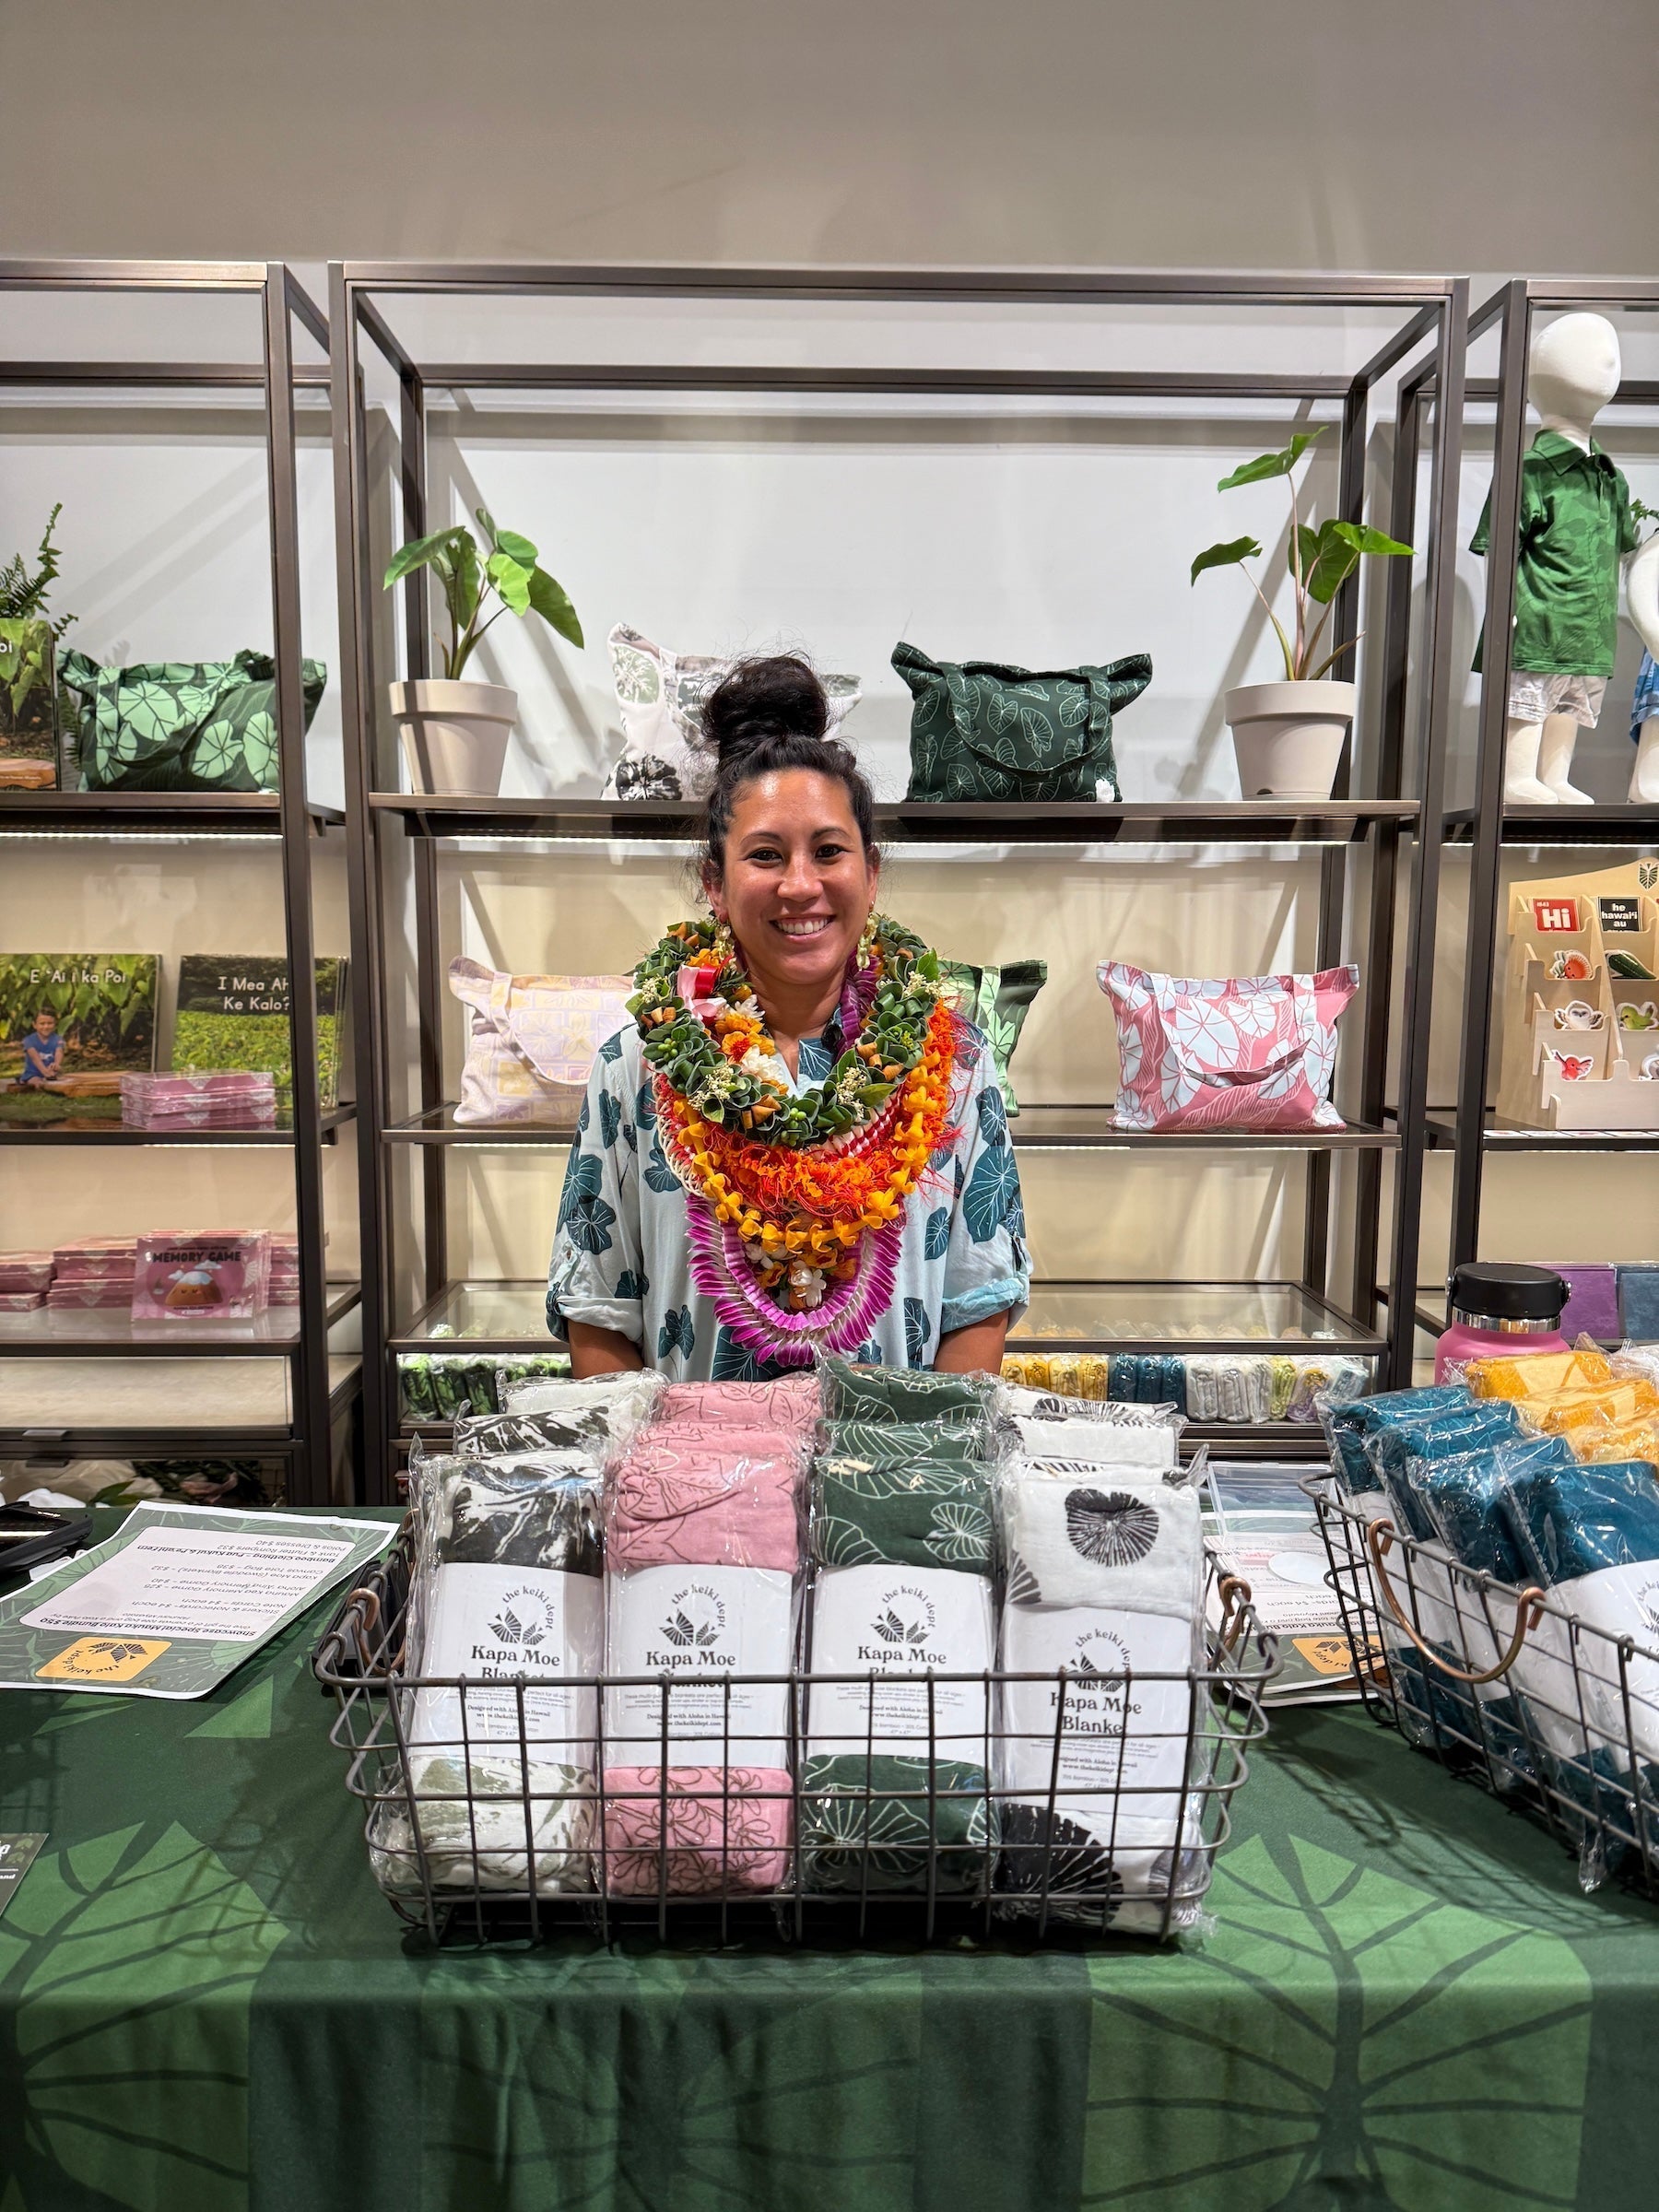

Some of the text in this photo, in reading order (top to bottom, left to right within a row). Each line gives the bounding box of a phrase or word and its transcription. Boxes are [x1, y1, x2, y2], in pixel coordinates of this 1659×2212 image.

[1611, 903, 1626, 912] he
[1541, 908, 1571, 929] Hi
[1613, 920, 1628, 928] au
[30, 969, 41, 983] E
[81, 969, 100, 983] ka
[104, 969, 126, 983] Poi
[218, 976, 228, 991] I
[232, 977, 265, 991] Mea
[223, 996, 290, 1011] Ke Kalo?
[152, 1251, 241, 1264] MEMORY GAME
[236, 1546, 277, 1554] Rompers
[253, 1553, 293, 1561] Clothing
[502, 1585, 555, 1630] the keiki dept
[671, 1583, 726, 1628] the keiki dept
[882, 1584, 936, 1628] the keiki dept
[40, 1618, 63, 1626] $50
[62, 1619, 100, 1628] Bundle
[160, 1625, 201, 1633] Special
[471, 1645, 560, 1666] Kapa Moe
[857, 1645, 947, 1665] Kapa Moe
[1075, 1629, 1131, 1672] the keiki dep
[646, 1651, 736, 1669] Kapa Moe
[96, 1665, 120, 1674] the
[1102, 1697, 1142, 1714] Moe
[1062, 1715, 1127, 1735] Blanke
